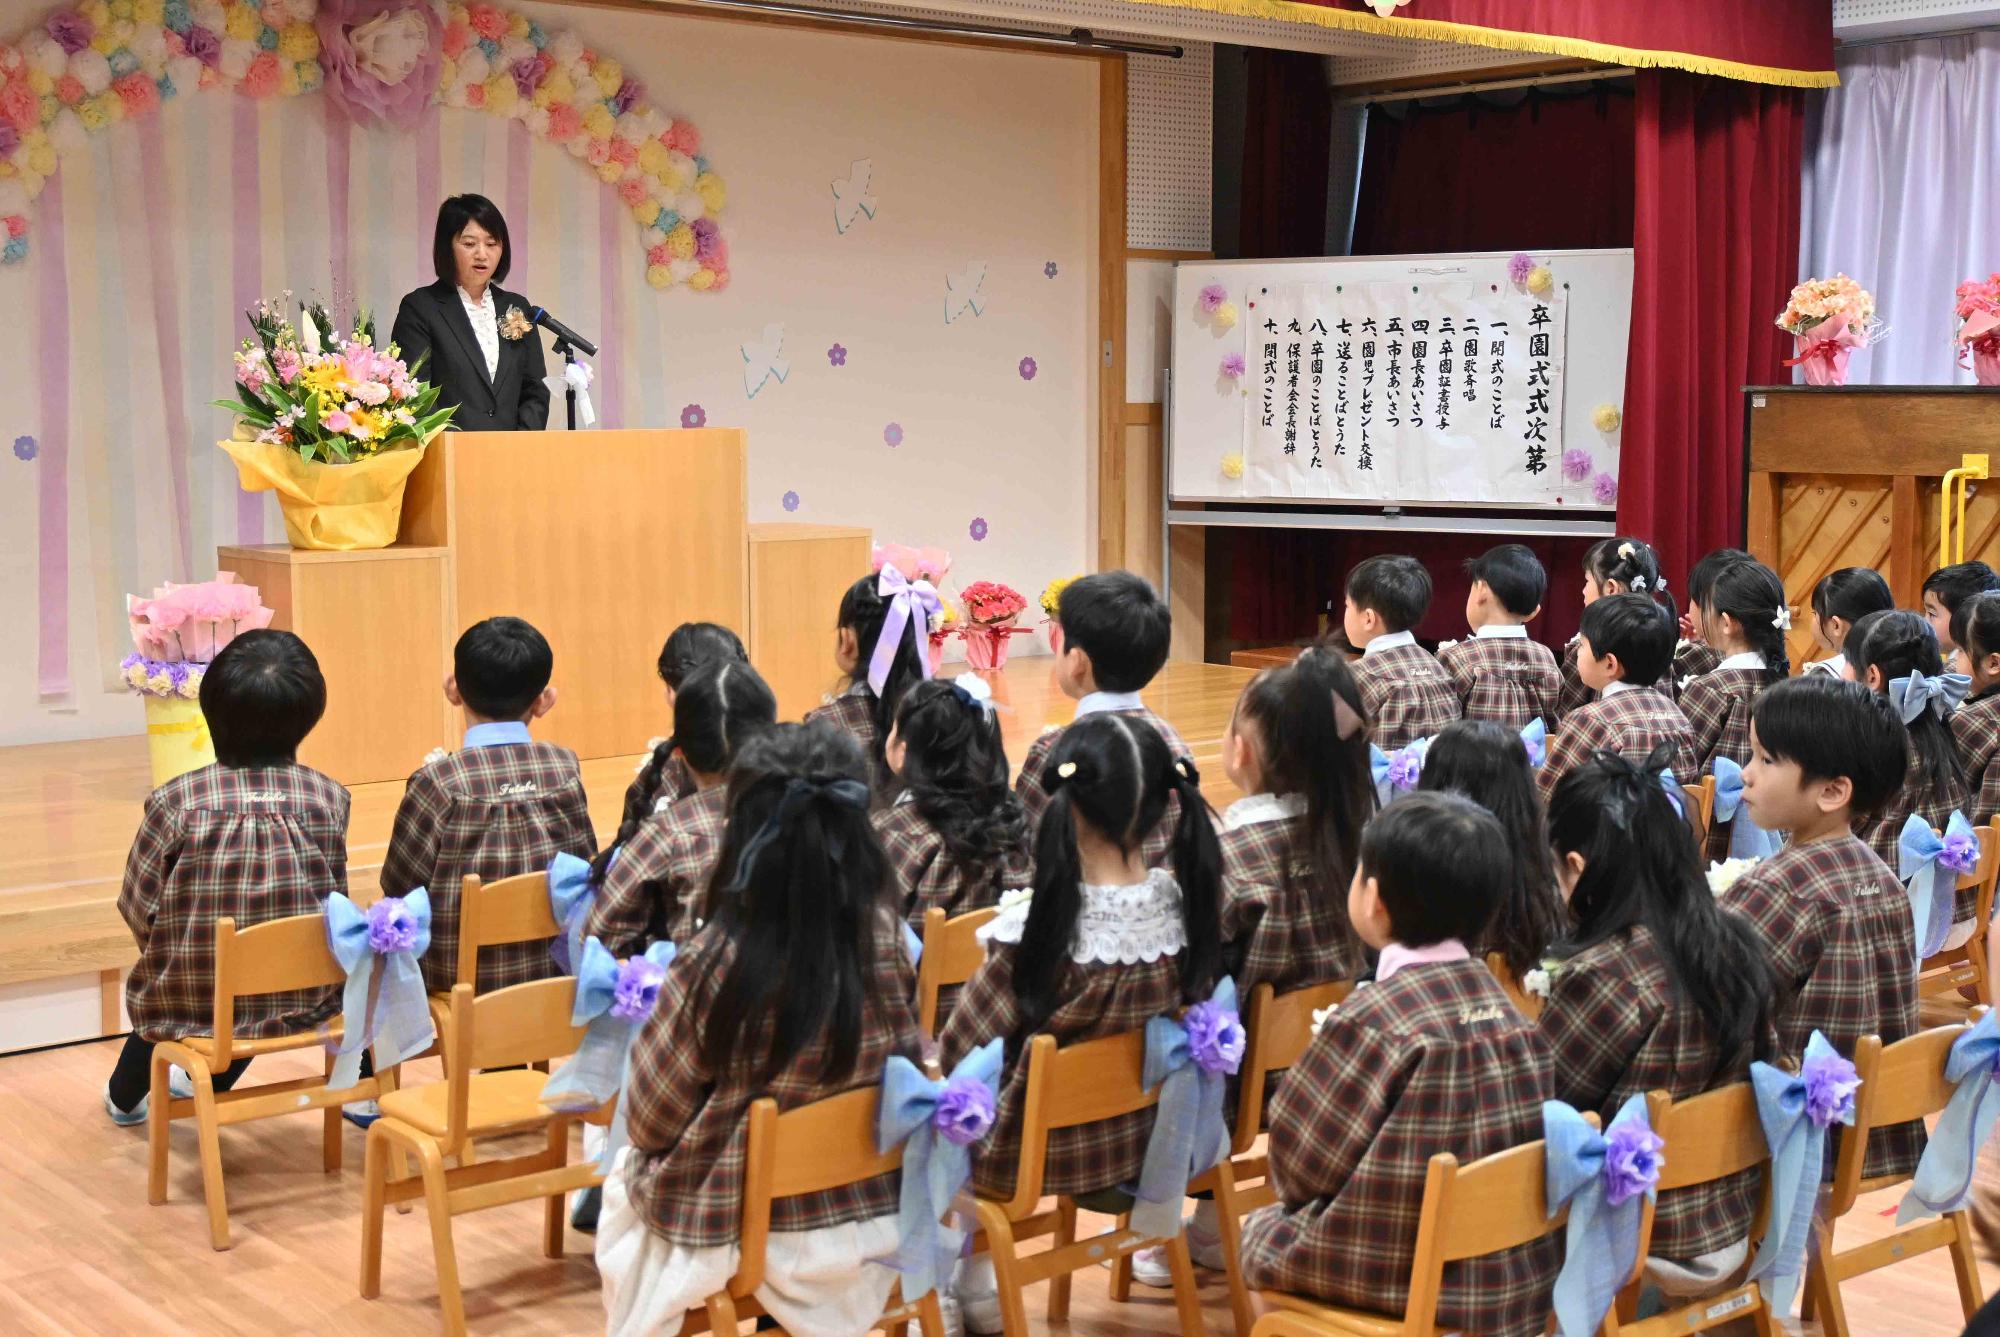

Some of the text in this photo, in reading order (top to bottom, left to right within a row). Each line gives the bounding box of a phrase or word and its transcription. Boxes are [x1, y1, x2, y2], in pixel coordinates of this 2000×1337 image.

[1384, 316, 1405, 427] 五、市長あいさつ
[1410, 319, 1430, 428] 四、園長あいさつ
[1523, 303, 1552, 476] 卒園式式次第
[498, 780, 537, 796] Futaba
